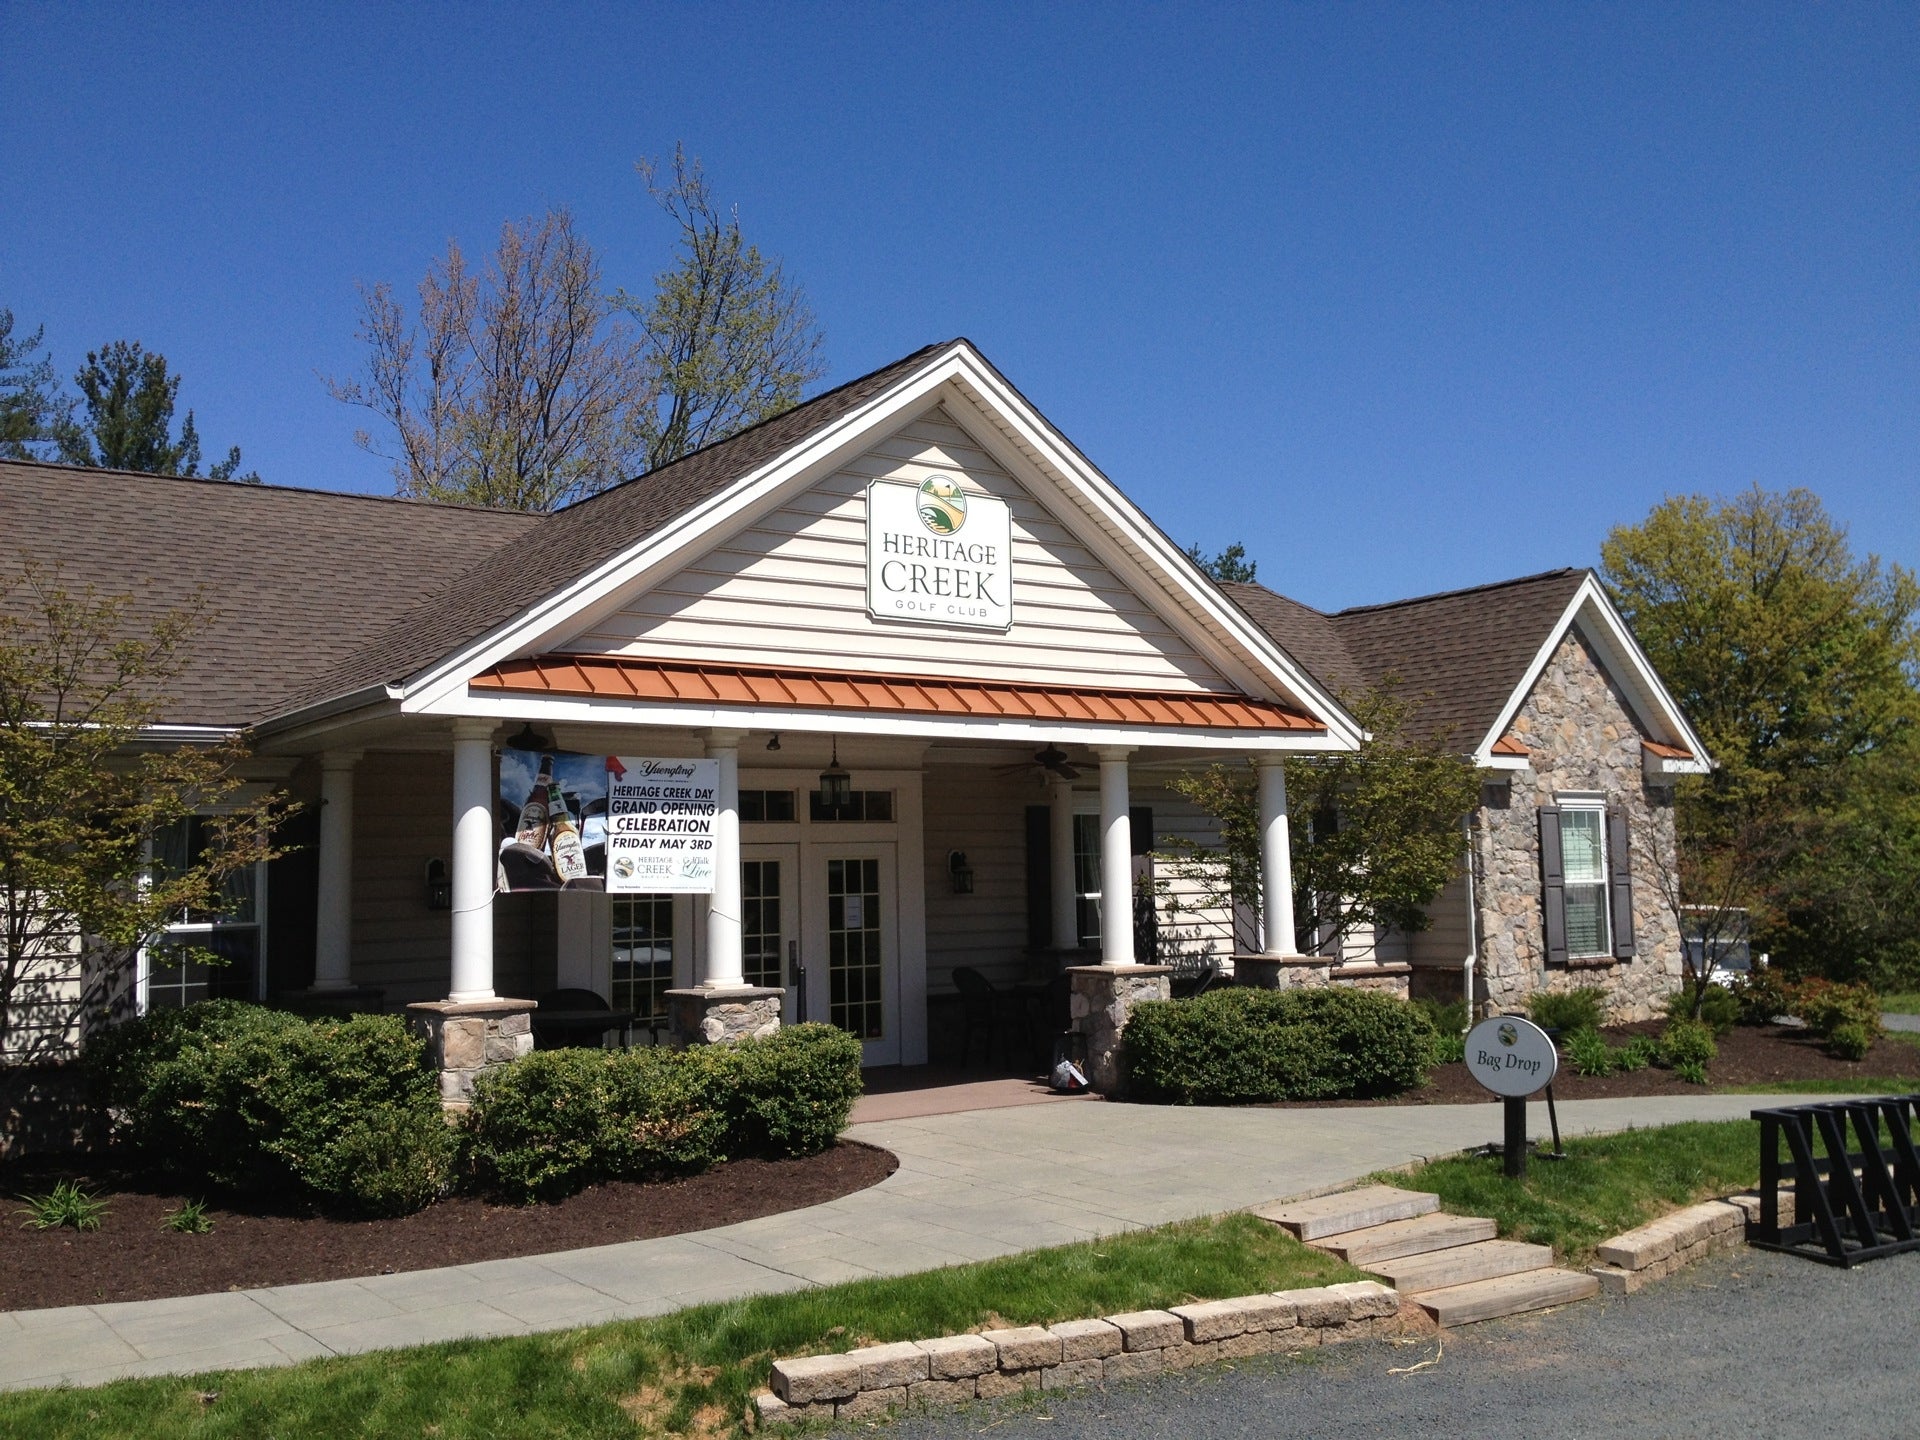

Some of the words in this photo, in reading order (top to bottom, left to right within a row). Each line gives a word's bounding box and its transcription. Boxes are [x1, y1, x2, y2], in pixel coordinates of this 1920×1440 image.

[883, 532, 997, 566] HERITAGE
[881, 560, 1006, 607] CREEK
[895, 600, 937, 612] GOLF
[947, 605, 988, 618] CLUB
[640, 760, 697, 778] Yuengling
[613, 785, 660, 797] HERITAGE
[663, 787, 692, 799] CREEK
[694, 788, 714, 800] DAY
[611, 800, 657, 814] GRAND
[661, 801, 715, 816] OPENING
[617, 817, 710, 833] CELEBRATION
[612, 837, 656, 849] FRIDAY
[659, 838, 687, 850] MAY
[689, 839, 713, 850] 3RD
[561, 863, 584, 873] LAGER
[638, 856, 673, 864] HERITAGE
[637, 864, 674, 875] CREEK
[1477, 1050, 1502, 1072] Bag
[1505, 1053, 1541, 1076] Drop
